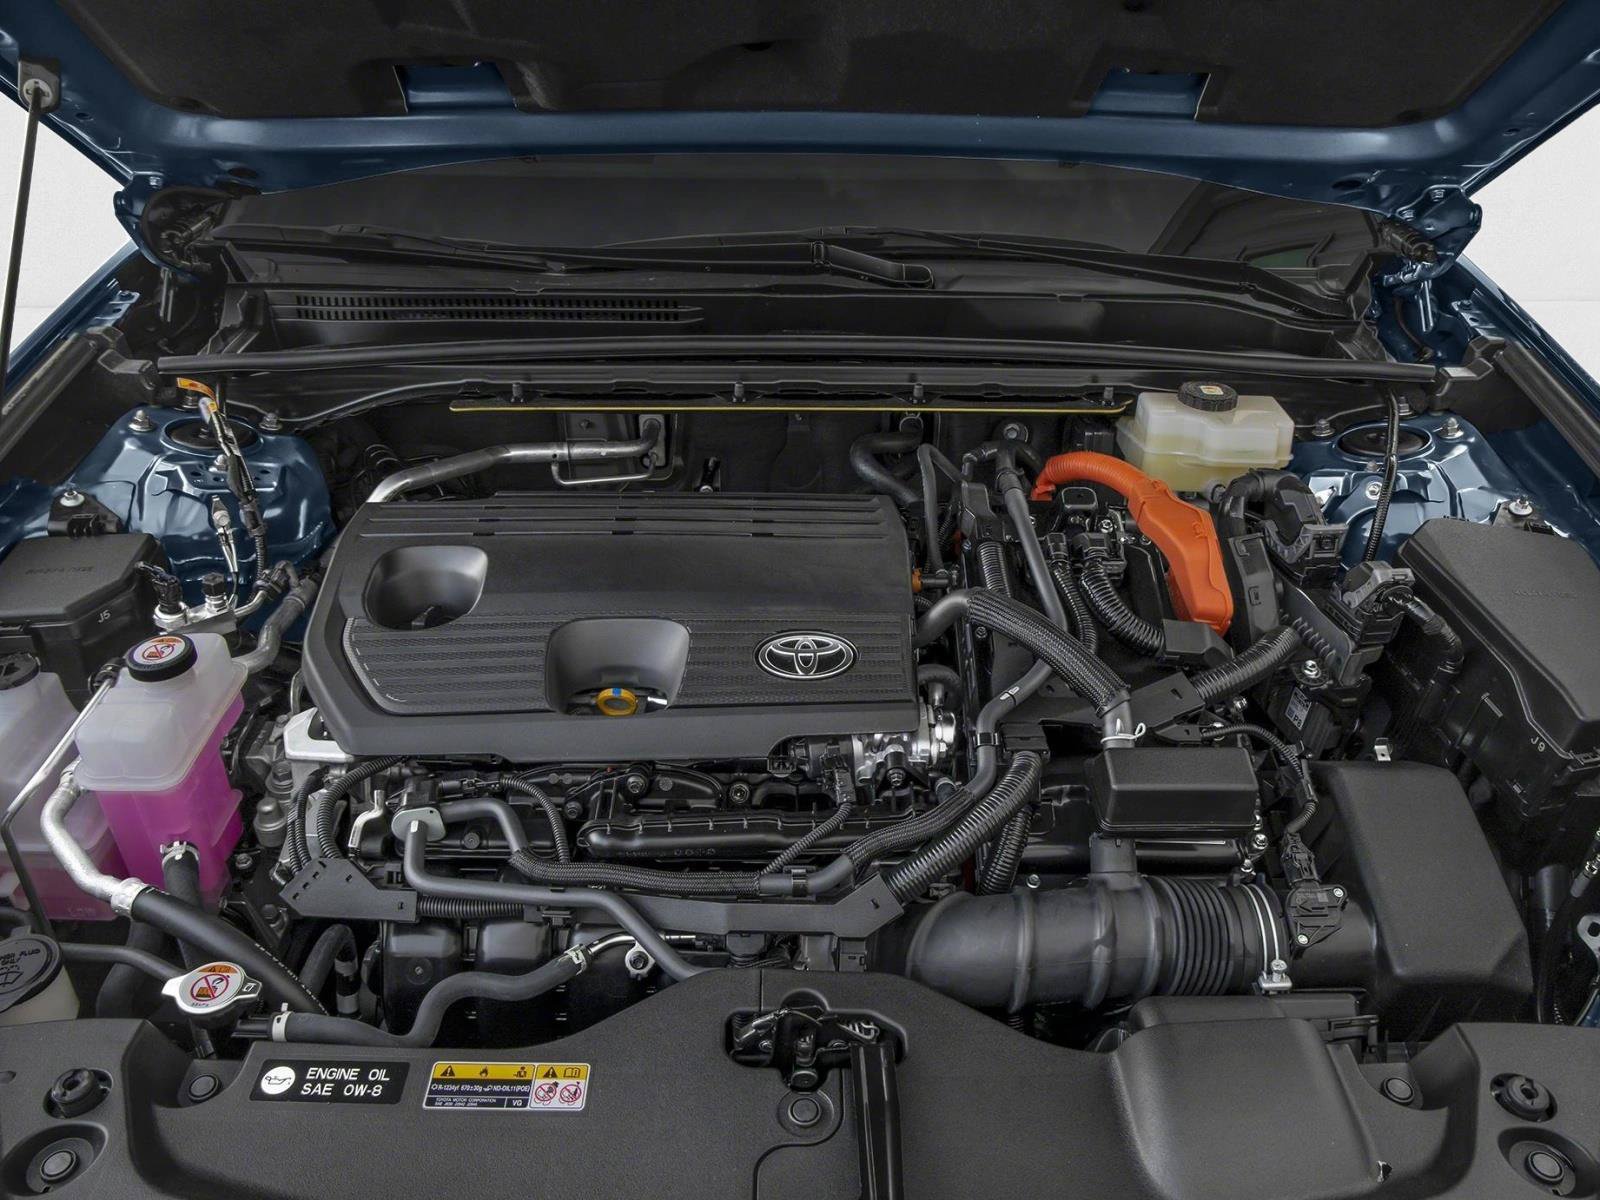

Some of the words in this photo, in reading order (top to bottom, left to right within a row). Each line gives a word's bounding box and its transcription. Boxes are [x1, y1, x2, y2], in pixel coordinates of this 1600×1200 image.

[98, 609, 111, 623] J5
[306, 1067, 361, 1081] ENGINE
[368, 1069, 390, 1081] OIL
[301, 1083, 335, 1096] SAE
[343, 1084, 383, 1097] 0W-8
